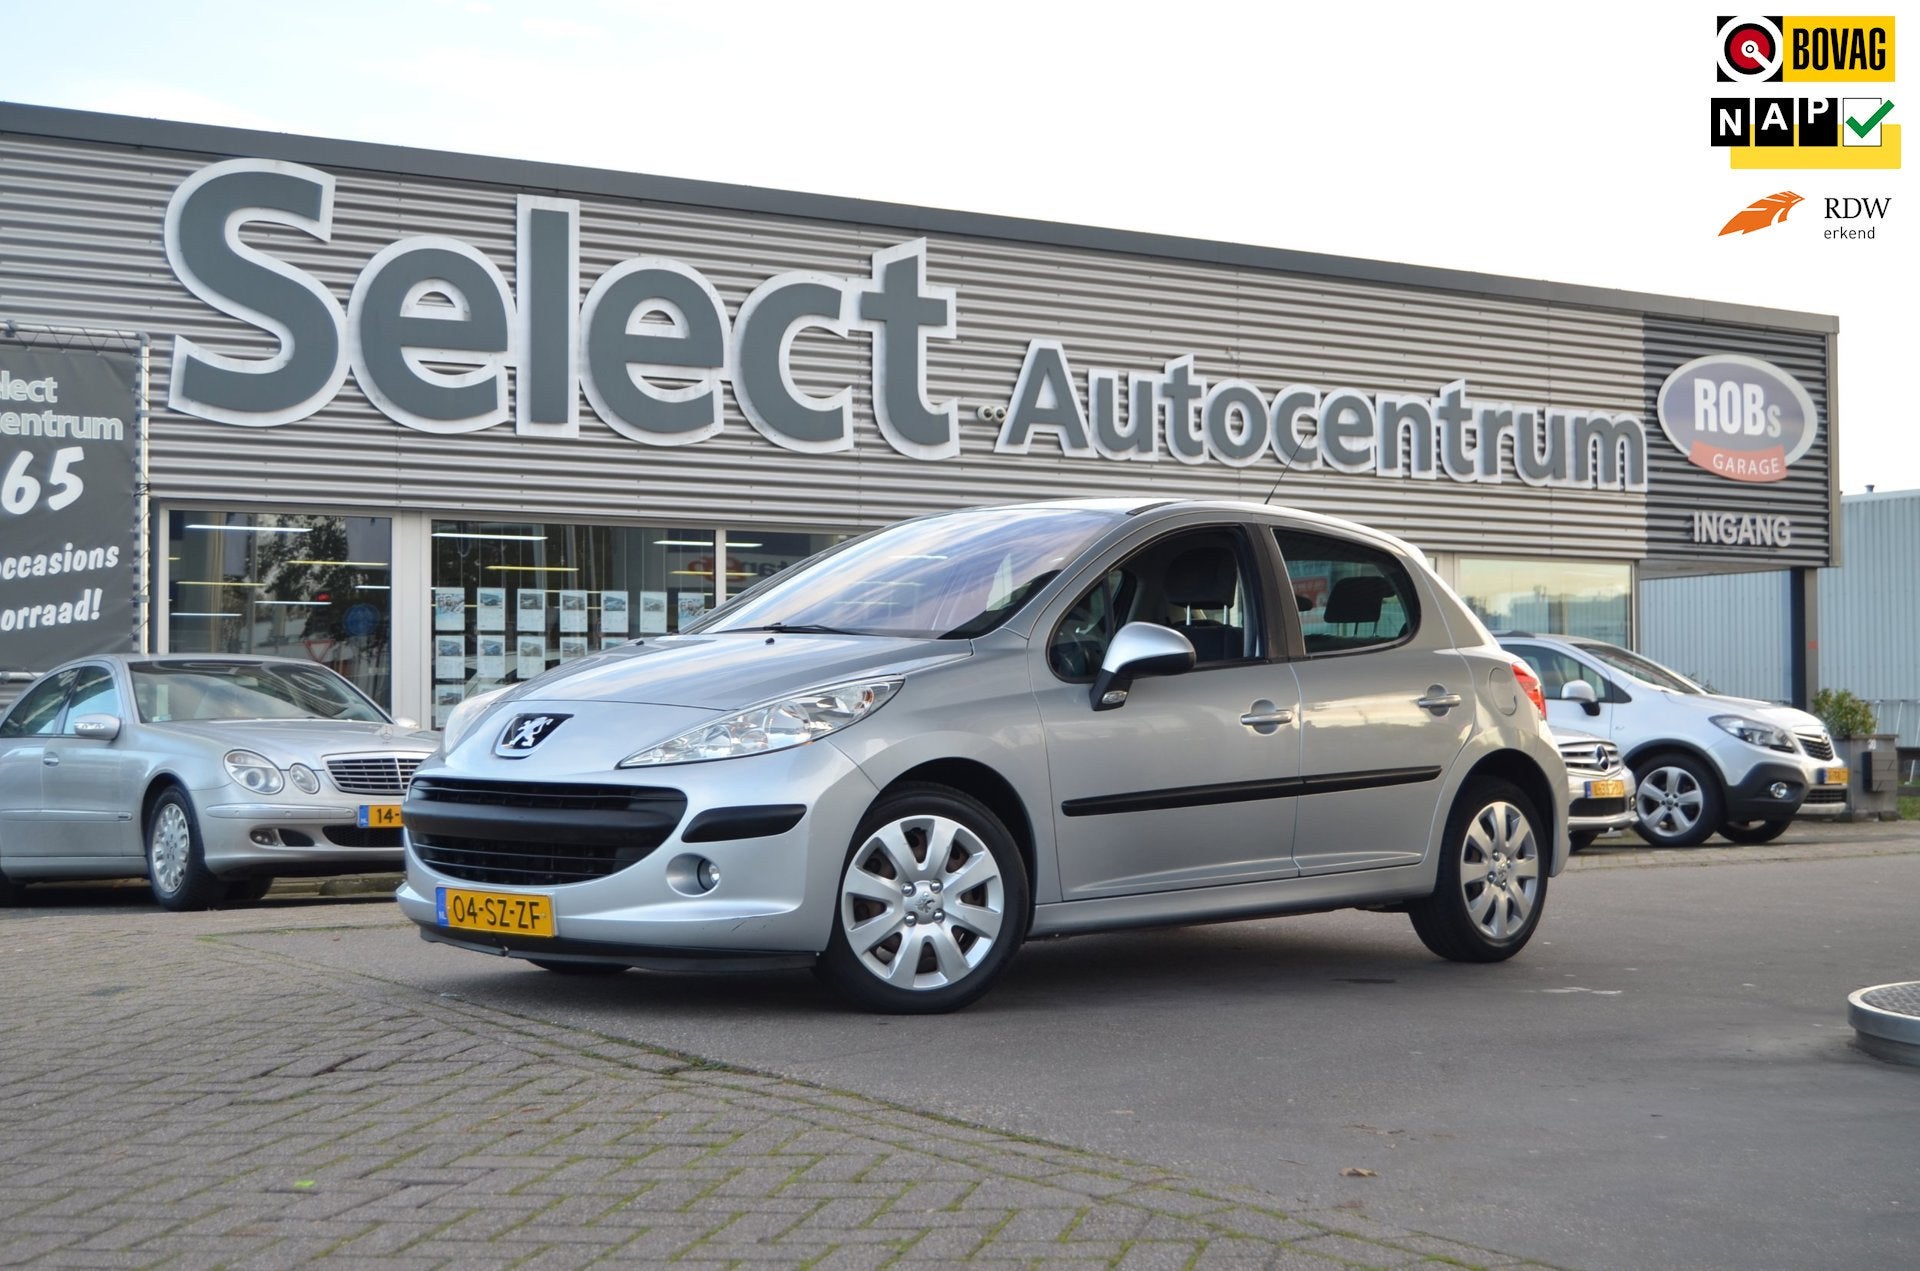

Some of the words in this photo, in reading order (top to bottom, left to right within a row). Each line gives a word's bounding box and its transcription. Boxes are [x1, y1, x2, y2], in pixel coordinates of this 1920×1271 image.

[164, 158, 961, 461] Select
[994, 338, 1648, 493] Autocentrum
[0, 370, 58, 403] lect
[0, 410, 124, 440] entrum
[1694, 378, 1782, 438] ROBs
[1, 446, 84, 515] 65
[1712, 453, 1780, 476] GARAGE
[1693, 511, 1791, 547] INGANG
[0, 542, 119, 580] ccasions
[453, 895, 542, 929] 04-SZ-ZF
